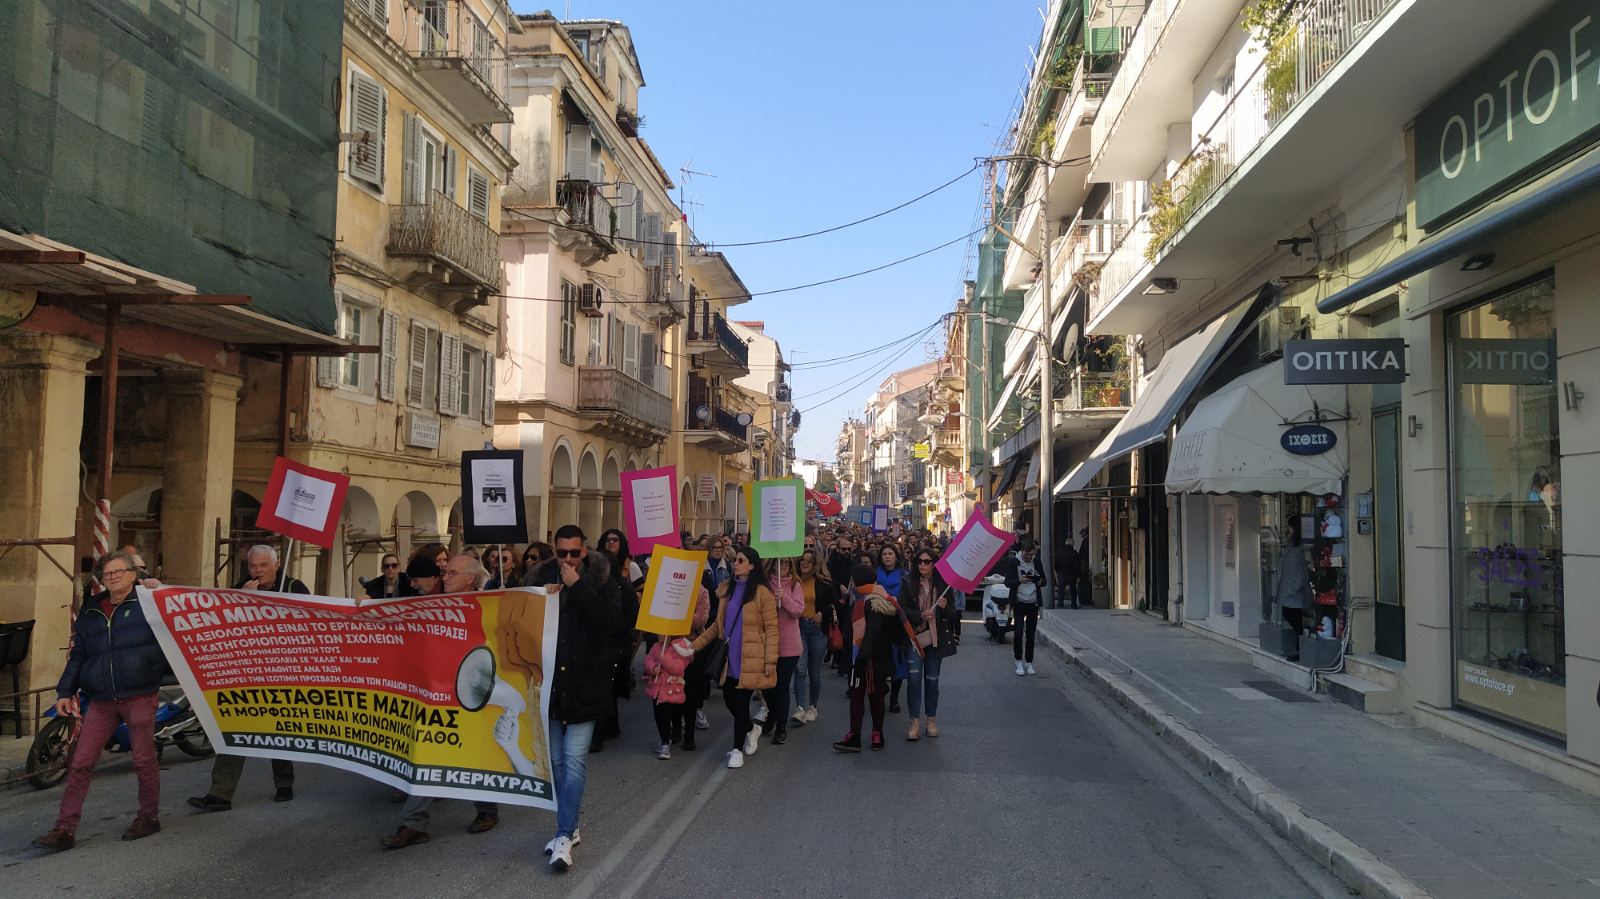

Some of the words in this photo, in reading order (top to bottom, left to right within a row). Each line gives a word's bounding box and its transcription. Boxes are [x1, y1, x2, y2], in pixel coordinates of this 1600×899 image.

[1440, 15, 1600, 179] OPTOF
[1292, 351, 1399, 370] ΟΠΤΙΚΑ
[1289, 433, 1328, 446] ΙΧΘΕΙΣ
[165, 592, 220, 614] ΑΥΤΟΙ
[380, 603, 414, 616] ΝΑ
[173, 611, 221, 631] ΔΕΝ
[223, 605, 311, 624] ΜΠΟΡΕΙ
[182, 635, 193, 643] Η
[196, 623, 275, 642] ΑΞΙΟΛΟΓΗΣΗ
[278, 622, 309, 633] ΕΙΝΑΙ
[310, 622, 327, 631] ΤΟ
[331, 622, 386, 631] ΕΡΓΑΛΕΙΟ
[408, 623, 424, 633] ΝΑ
[426, 623, 467, 640] ΠΕΡΑΣΕΙ
[188, 646, 199, 655] Η
[200, 635, 315, 653] ΚΑΤΗΓΟΡΙΟΠΟΙΗΣΗ
[317, 634, 343, 644] ΤΩΝ
[346, 634, 404, 645] ΣΧΟΛΕΙΩΝ
[197, 653, 234, 661] ΜΕΙΩΝΕΙ
[248, 647, 319, 656] ΧΡΗΜΑΤΟΔΟΤΗΣΗ
[320, 646, 341, 654] ΤΟΥΣ
[201, 659, 252, 670] ΜΕΤΑΤΡΕΠΕΙ
[265, 656, 298, 664] ΣΧΟΛΕΙΑ
[206, 668, 241, 678] ΑΥΞΑΝΕΙ
[209, 677, 246, 686] ΚΑΤΑΡΓΕΙ
[341, 676, 365, 684] ΟΛΩΝ
[366, 677, 381, 685] ΤΩΝ
[217, 689, 367, 709] ΑΝΤΙΣΤΑΘΕΙΤΕ
[373, 694, 414, 721] ΜΑΖΙ
[219, 707, 231, 717] Η
[234, 706, 309, 719] ΜΟΡΦΩΣΗ
[313, 708, 349, 722] ΕΙΝΑΙ
[352, 711, 411, 738] ΚΟΙΝΩΝΙΚΟ
[276, 721, 302, 733] ΔΕΝ
[306, 722, 340, 737] ΕΙΝΑΙ
[345, 727, 410, 756] ΕΜΠΟΡΕΥΜΑ
[232, 734, 315, 750] ΣΥΛΛΟΓΟΣ
[318, 741, 413, 779] ΕΚΠΑΙΔΕΥΤΙΚΩΝ
[415, 767, 442, 782] ΠΕ
[445, 770, 544, 794] ΚΕΡΚΥΡΑΣ
